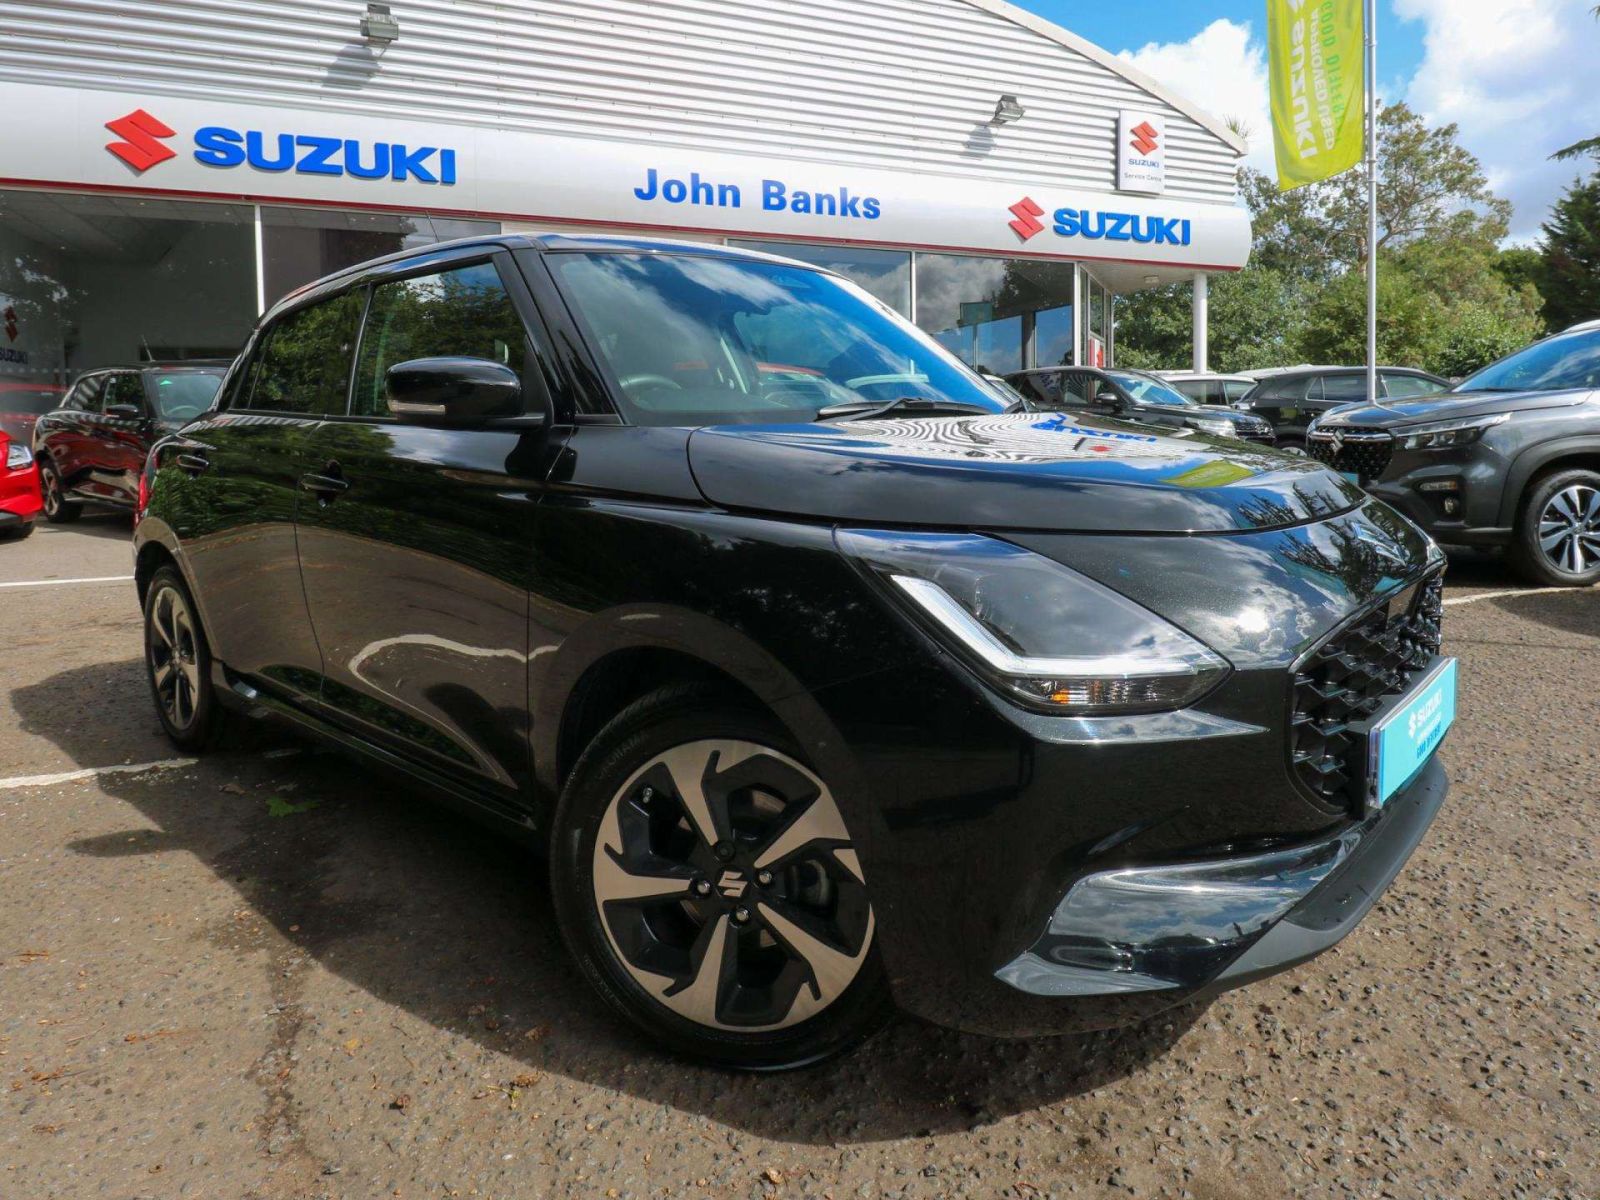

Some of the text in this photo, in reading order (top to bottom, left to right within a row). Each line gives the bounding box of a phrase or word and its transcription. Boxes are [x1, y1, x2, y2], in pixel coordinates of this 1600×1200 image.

[193, 126, 456, 185] SUZUKI
[1128, 158, 1160, 168] SUZUKI
[634, 168, 881, 220] John Banks
[1124, 172, 1145, 180] Service
[1052, 207, 1191, 246] SUZUKI
